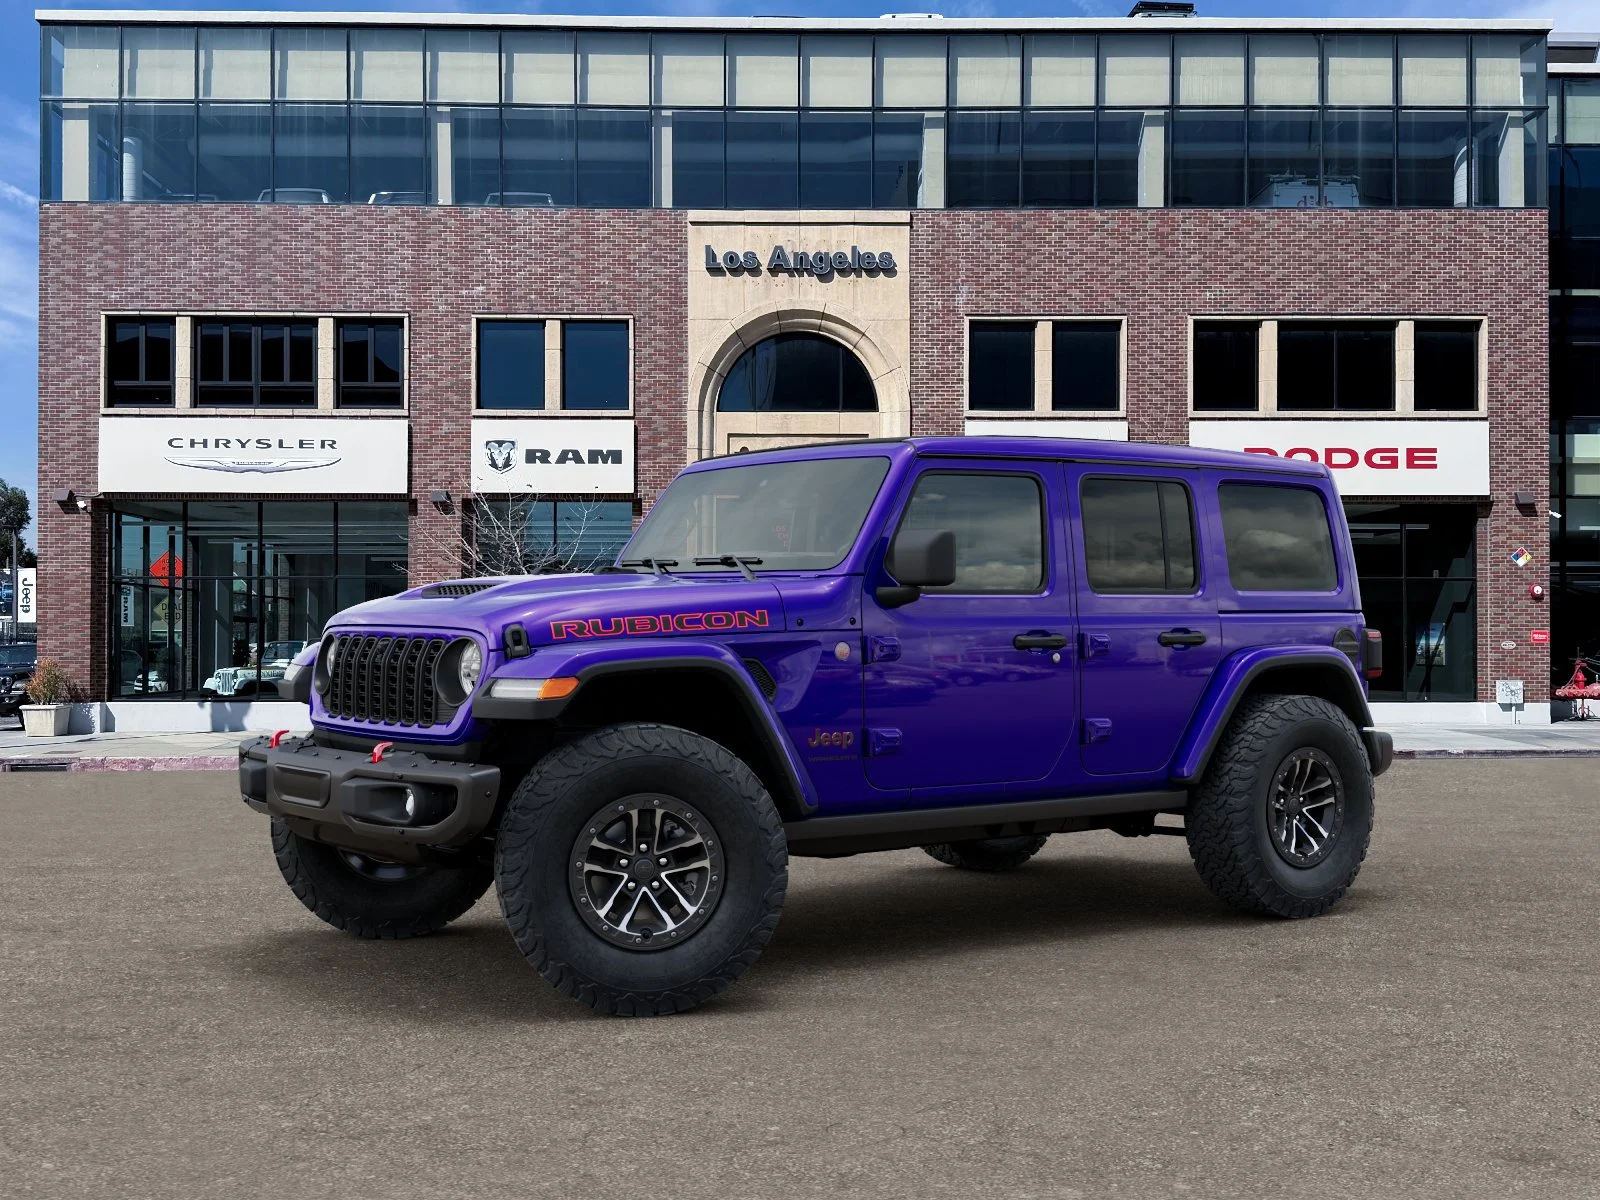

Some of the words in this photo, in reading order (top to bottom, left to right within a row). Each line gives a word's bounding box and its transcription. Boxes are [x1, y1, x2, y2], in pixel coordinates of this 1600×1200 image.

[705, 245, 759, 269] Los
[768, 245, 895, 276] Angeles
[167, 437, 338, 450] CHRYSLER
[524, 448, 623, 465] RAM
[20, 578, 33, 613] Jeep
[549, 609, 769, 640] RUBICON
[807, 728, 854, 749] Jeep
